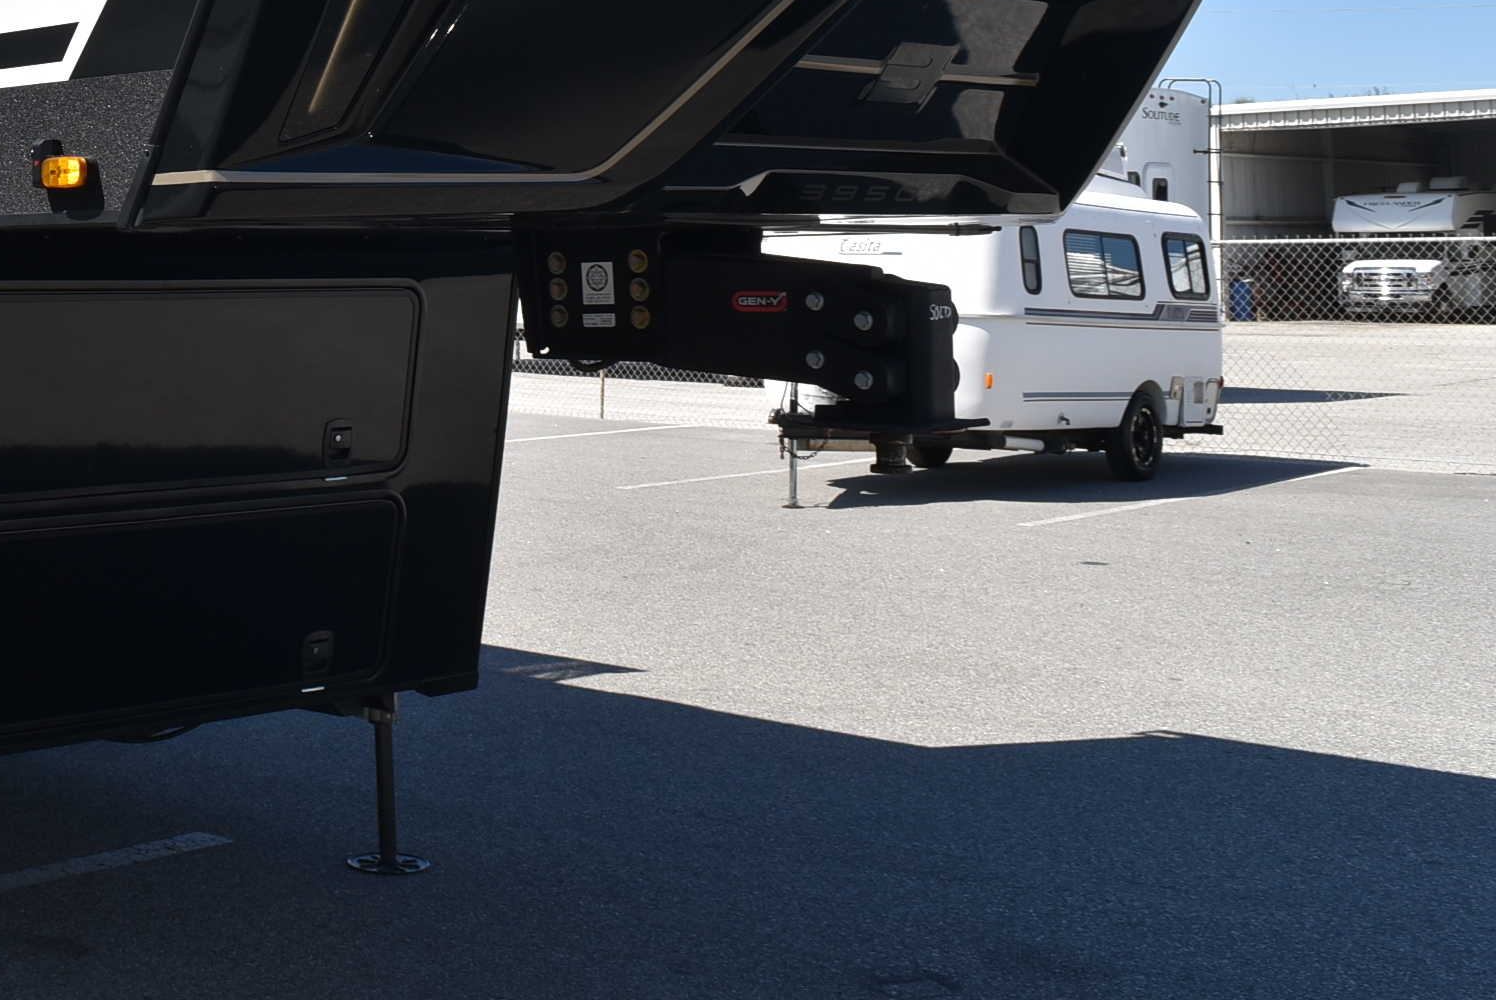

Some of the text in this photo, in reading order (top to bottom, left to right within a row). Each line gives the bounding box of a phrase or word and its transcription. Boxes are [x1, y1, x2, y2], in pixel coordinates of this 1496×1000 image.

[1142, 106, 1181, 122] SOLITUDE
[799, 184, 920, 202] 3950
[737, 291, 787, 306] GEN-Y
